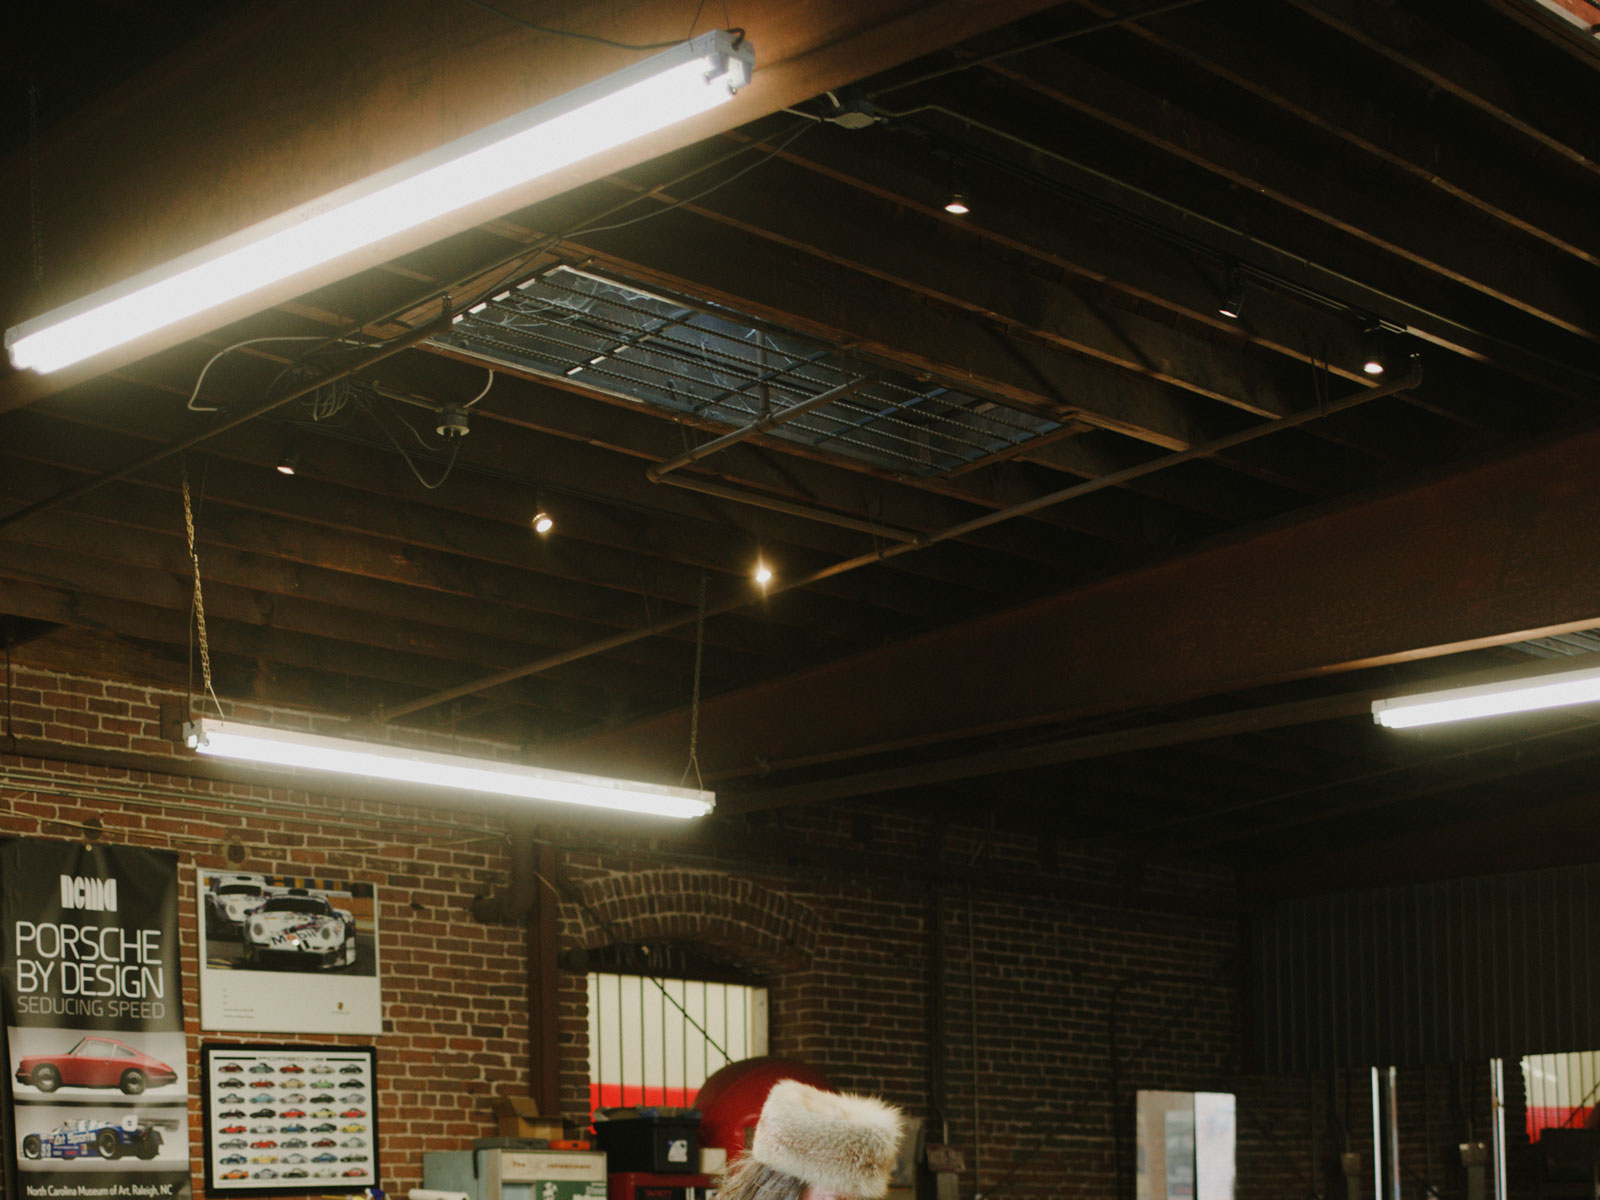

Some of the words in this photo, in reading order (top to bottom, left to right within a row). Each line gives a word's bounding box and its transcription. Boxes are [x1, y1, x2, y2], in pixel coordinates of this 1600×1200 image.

[15, 921, 162, 965] PORSCHE
[271, 927, 318, 947] Mobil
[16, 959, 55, 993] BY
[61, 961, 164, 999] DESIGN
[17, 996, 104, 1017] SEDUCING
[108, 1000, 165, 1019] SPEED
[26, 1185, 47, 1197] North
[48, 1185, 77, 1197] Carolina
[78, 1185, 109, 1197] Museum
[109, 1184, 118, 1196] of
[119, 1184, 131, 1197] Art,
[132, 1184, 159, 1198] Raleigh,
[160, 1184, 174, 1196] NC
